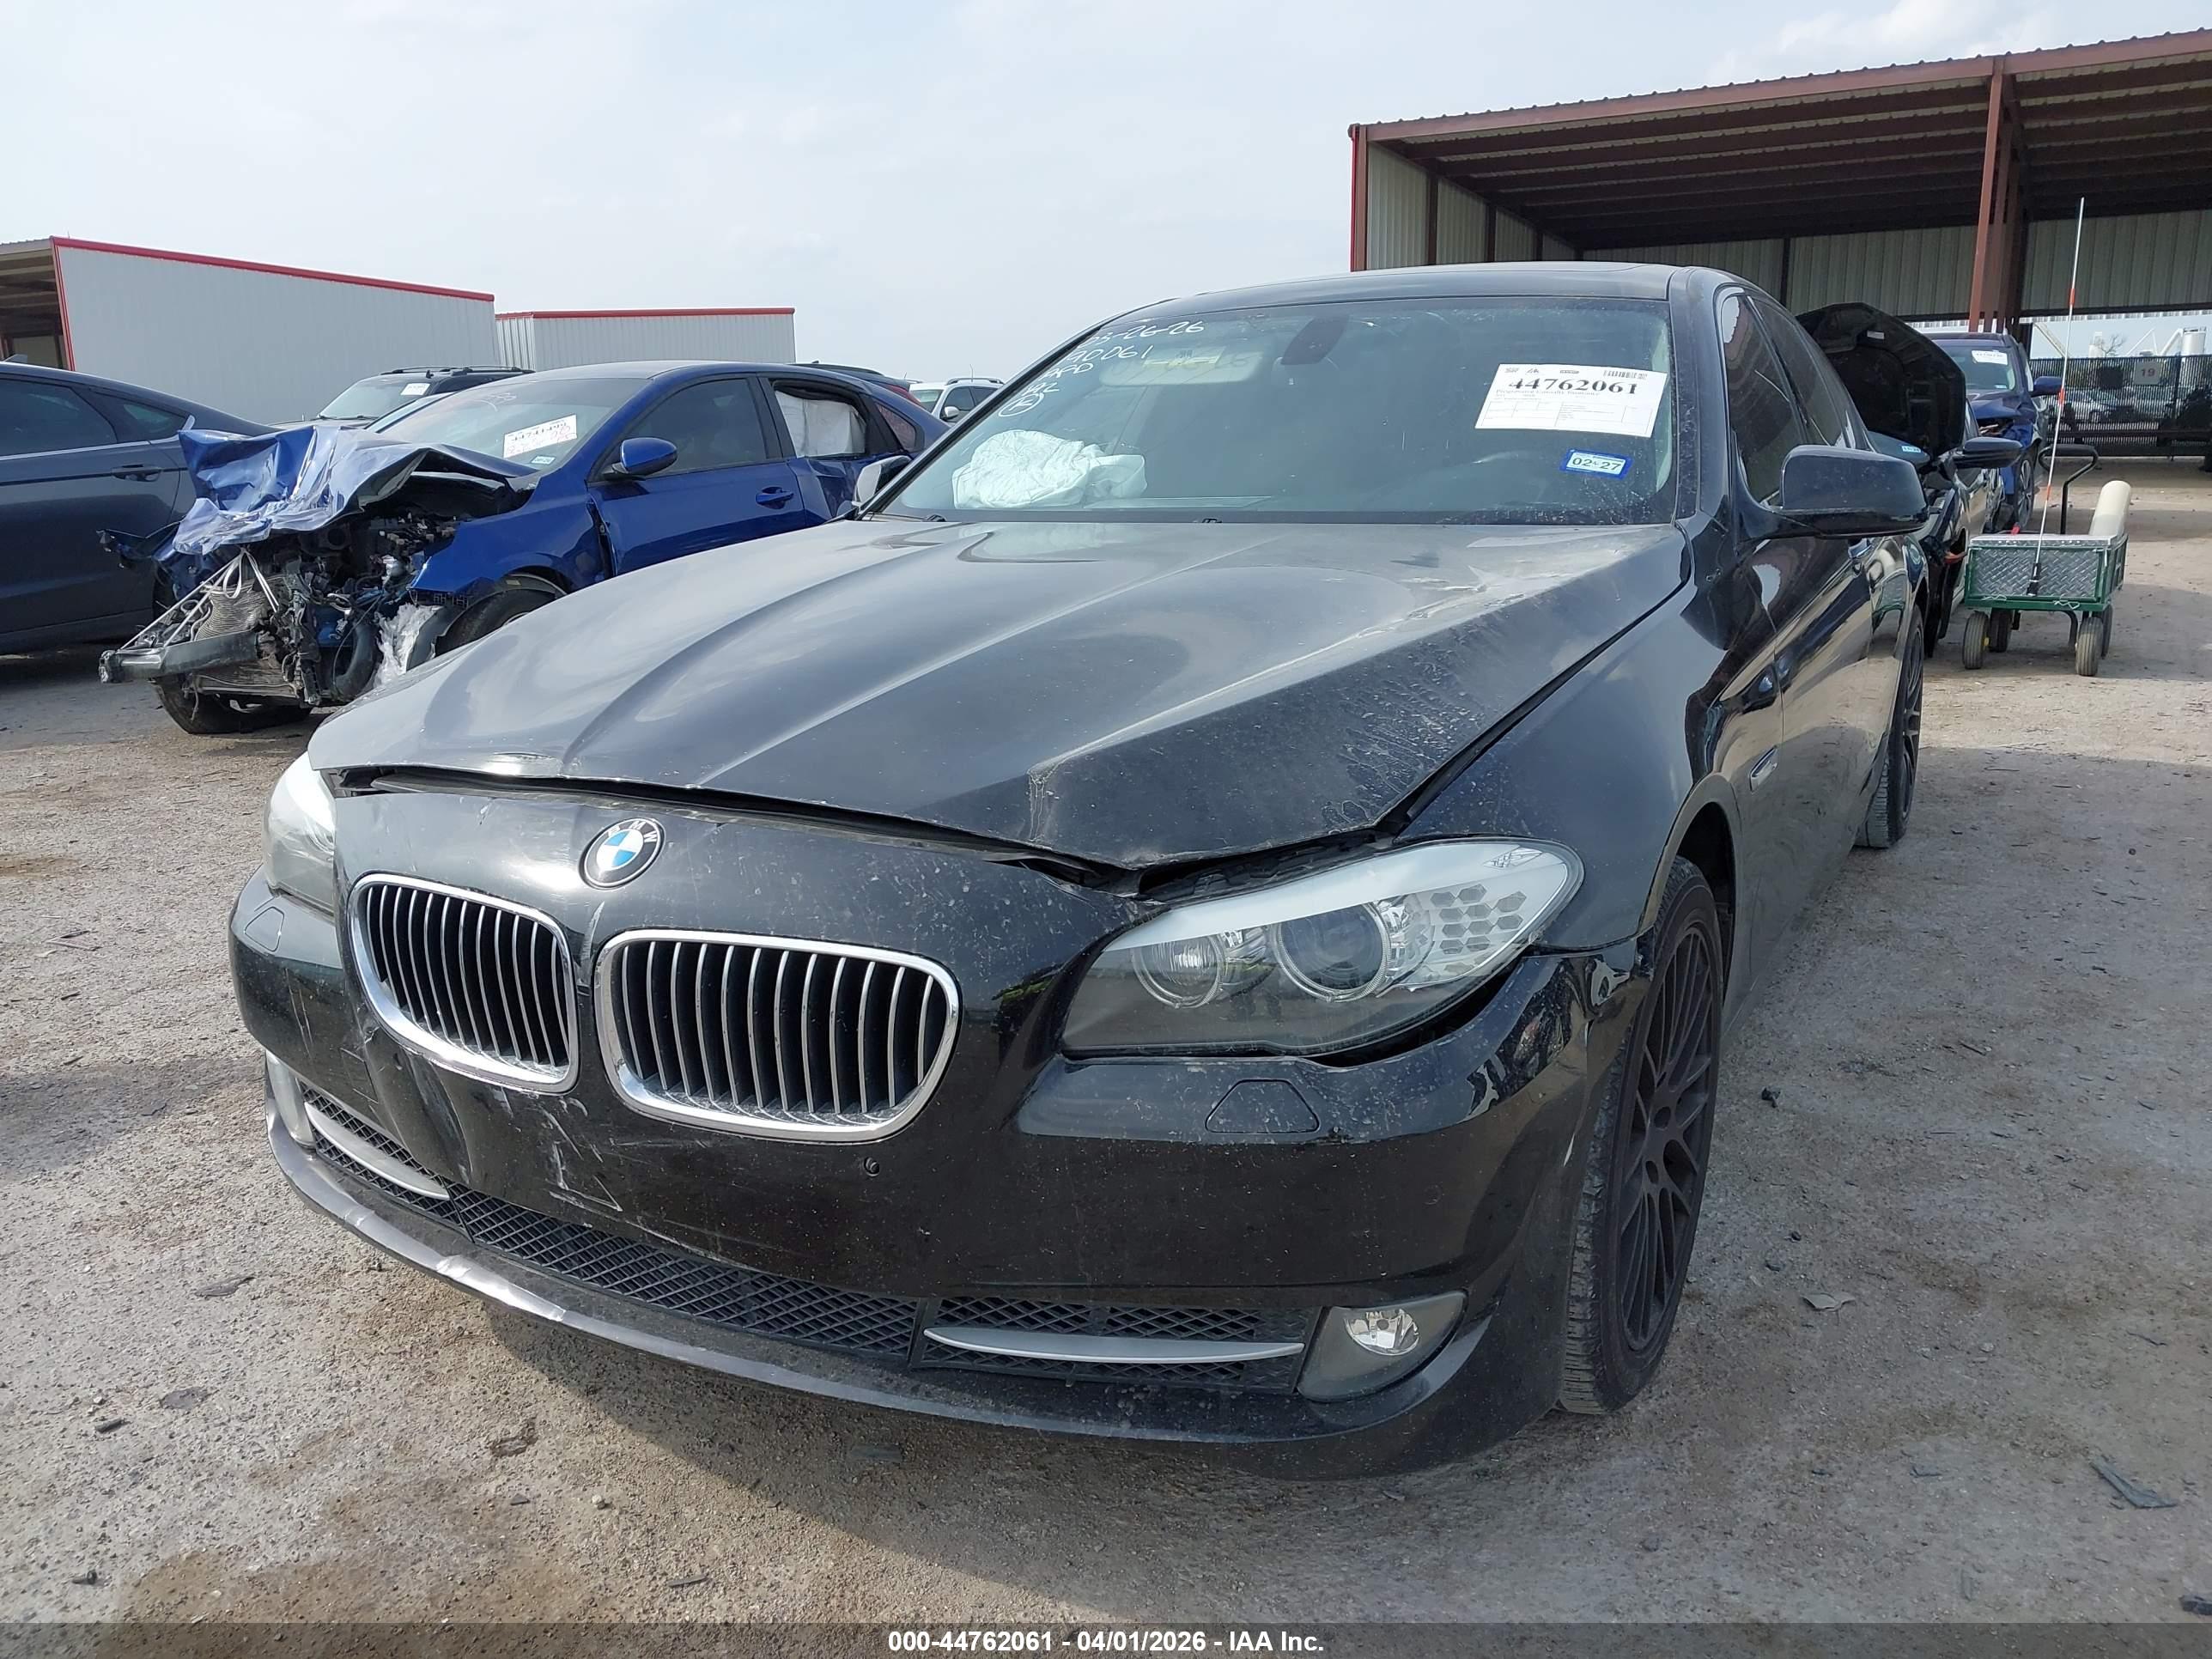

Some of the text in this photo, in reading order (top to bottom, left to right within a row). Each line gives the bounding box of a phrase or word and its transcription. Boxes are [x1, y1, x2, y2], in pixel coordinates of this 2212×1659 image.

[2141, 368, 2156, 377] 19
[1508, 377, 1638, 395] 44762061
[1572, 457, 1622, 471] 02 27
[607, 820, 659, 843] BMW
